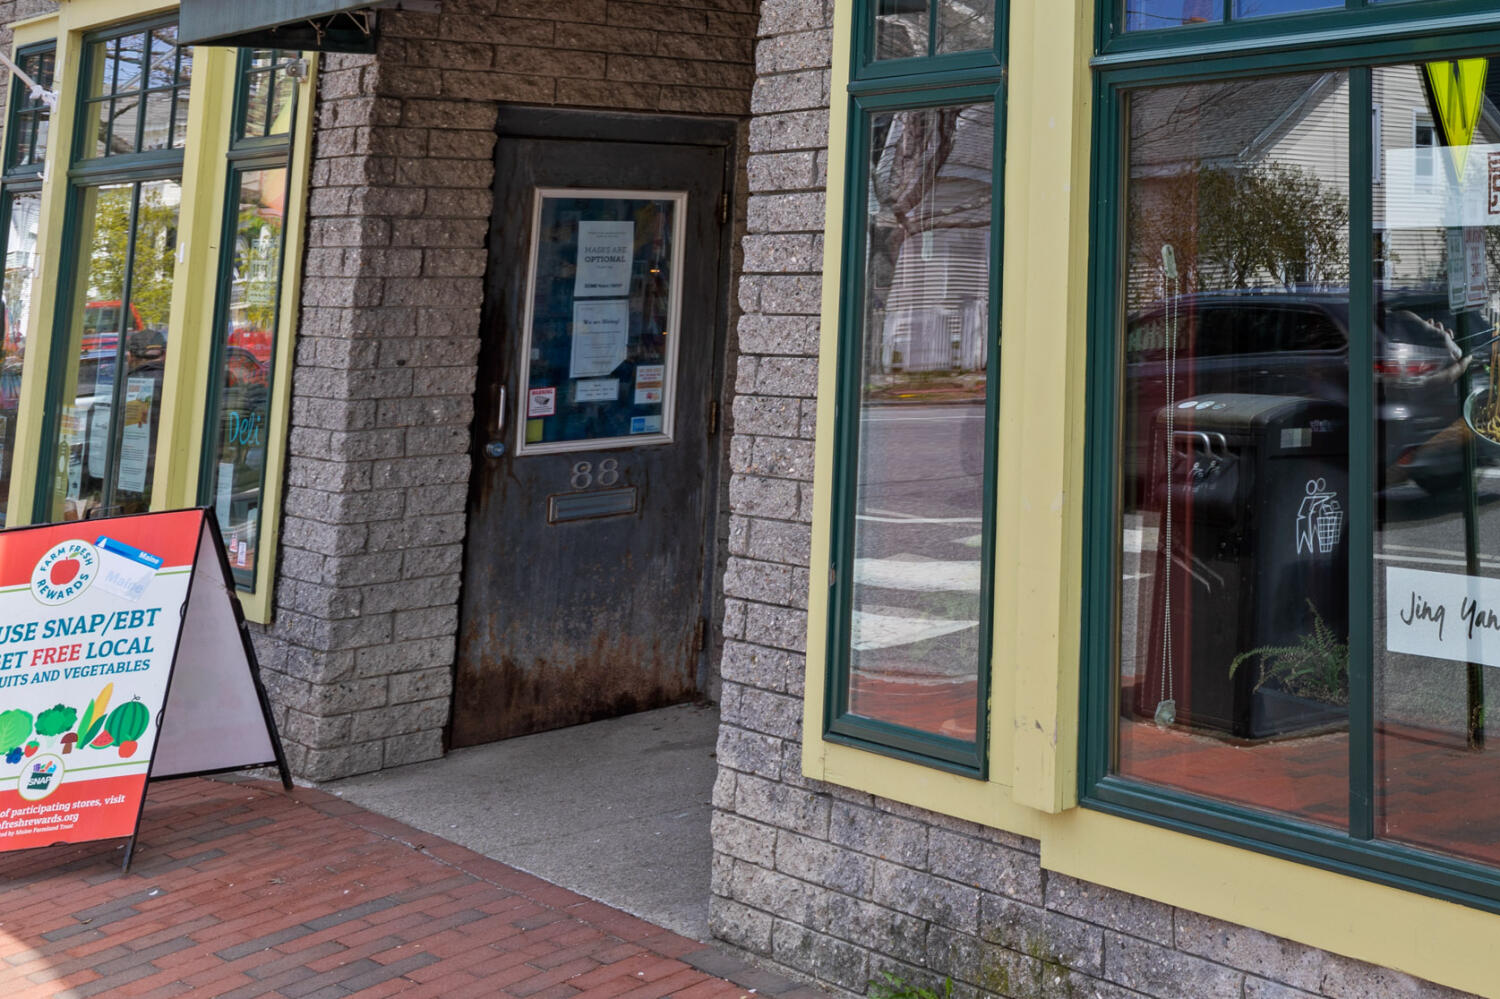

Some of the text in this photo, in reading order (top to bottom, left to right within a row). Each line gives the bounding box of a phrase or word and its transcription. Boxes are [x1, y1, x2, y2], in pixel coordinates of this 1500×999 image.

[584, 255, 627, 264] OPTIONAL
[228, 410, 261, 446] Deli
[570, 458, 619, 489] 88
[40, 544, 93, 572] FARM FRESH
[138, 551, 160, 565] Maine
[37, 573, 90, 600] REWARDS
[0, 608, 162, 645] USE SNAP/EBT
[1460, 596, 1500, 639] Yan
[0, 636, 154, 671] ET FREE LOCAL
[30, 669, 60, 684] AND
[64, 658, 151, 680] VEGETABLES
[28, 776, 52, 786] SNAP
[10, 801, 71, 819] participating
[104, 794, 126, 805] visit
[0, 813, 79, 830] freshrewards.org
